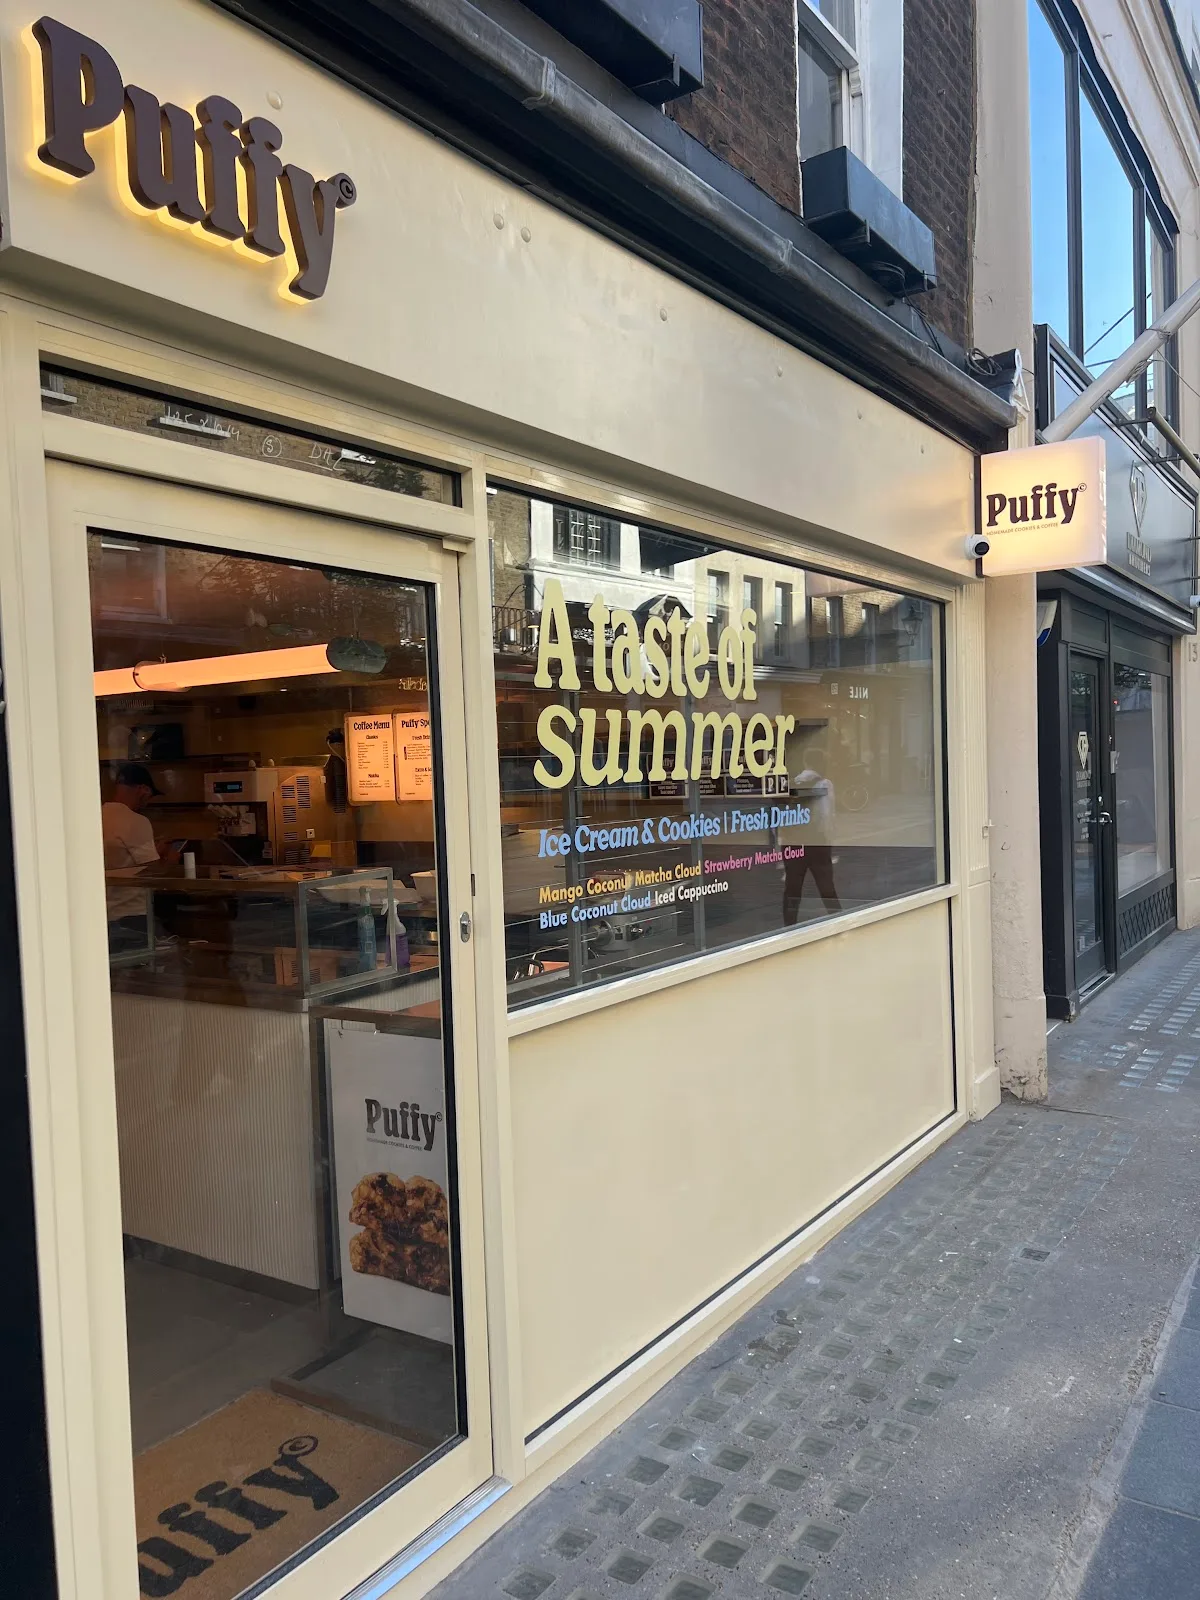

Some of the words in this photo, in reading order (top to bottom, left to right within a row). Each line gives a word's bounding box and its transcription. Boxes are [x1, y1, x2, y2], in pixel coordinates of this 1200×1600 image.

[32, 15, 343, 301] Puffy
[986, 483, 1079, 527] Puffy
[1014, 525, 1036, 533] COOKIES
[1041, 521, 1059, 529] COFFEE
[534, 578, 581, 691] A
[588, 593, 710, 699] taste
[717, 607, 758, 701] of
[353, 721, 373, 731] Coffee
[374, 720, 390, 729] Menu
[401, 719, 419, 729] Puffy
[533, 704, 796, 789] summer
[538, 829, 571, 858] Ice
[575, 825, 639, 853] Cream
[641, 818, 655, 845] &
[658, 812, 720, 842] Cookies
[731, 806, 769, 834] Fresh
[770, 803, 811, 828] Drinks
[539, 886, 584, 903] Mango
[586, 873, 632, 895] Coconut
[635, 866, 673, 887] Matcha
[674, 860, 702, 880] Cloud
[704, 854, 753, 875] Strawberry
[754, 848, 783, 866] Matcha
[784, 844, 805, 860] Cloud
[539, 909, 568, 930] Blue
[571, 900, 618, 923] Coconut
[621, 891, 651, 912] Cloud
[655, 886, 676, 906] Iced
[677, 878, 729, 902] Cappuccino
[364, 1098, 436, 1152] Puffy
[137, 1454, 340, 1598] uffy
